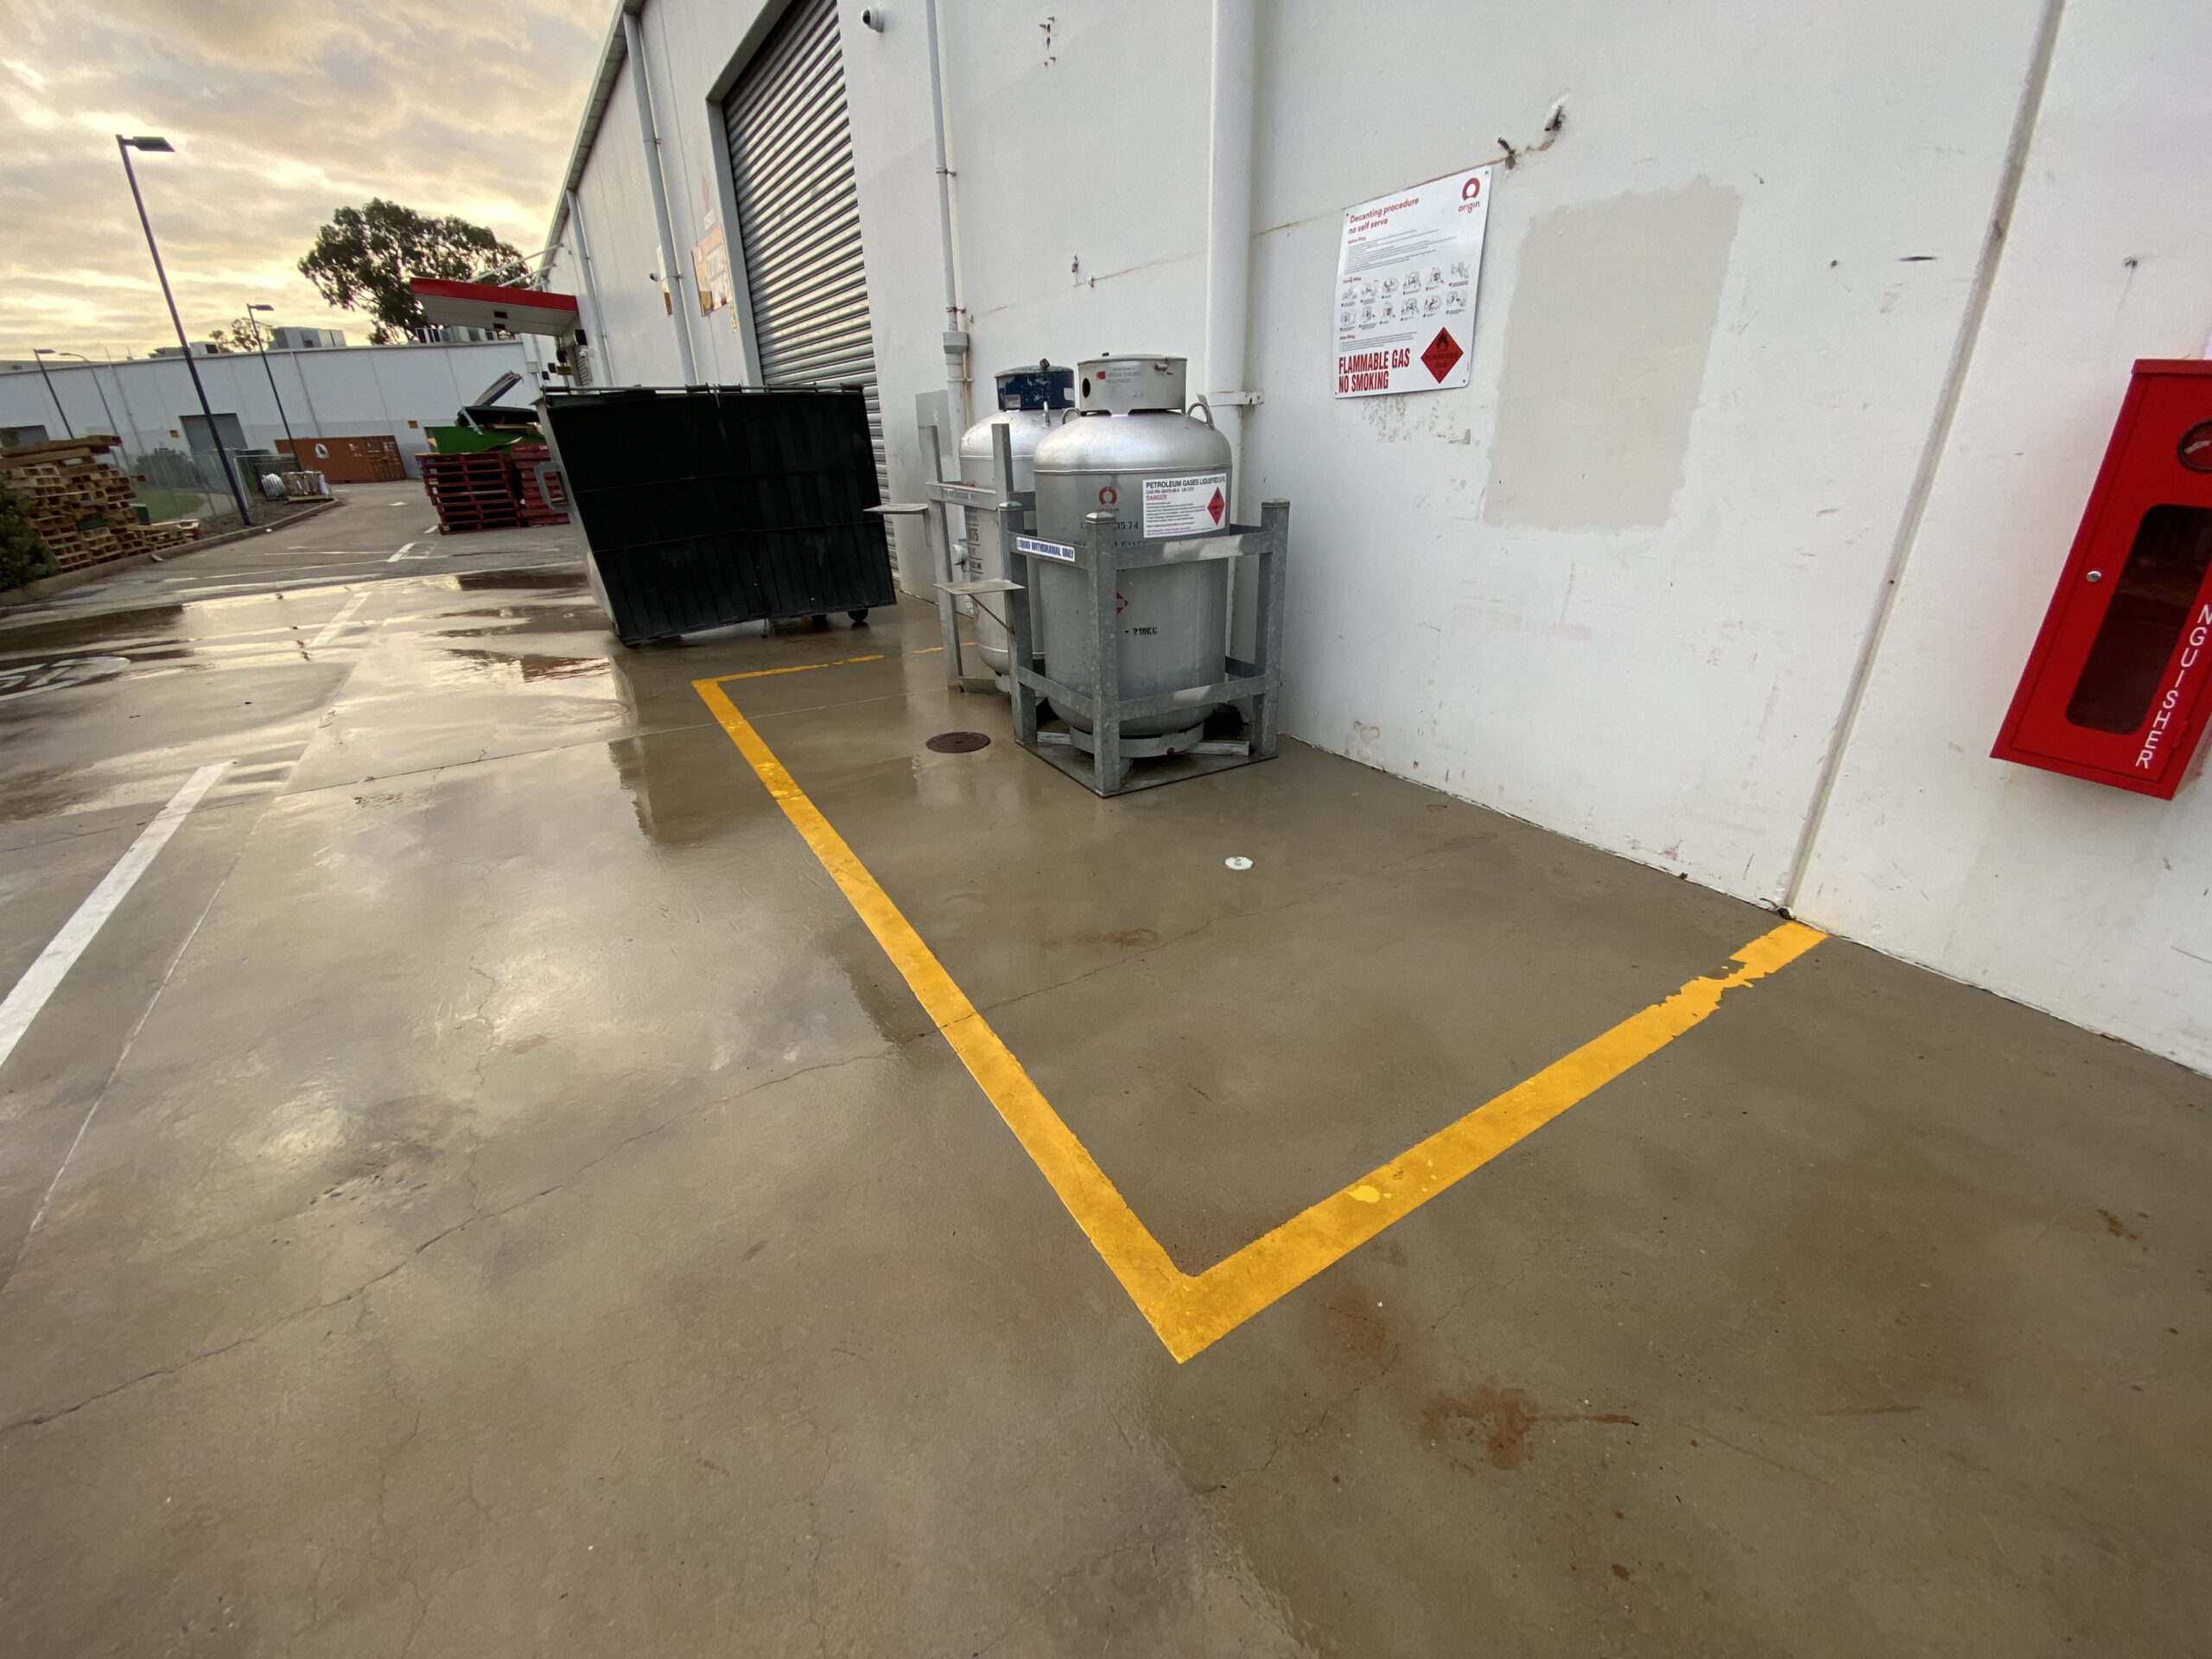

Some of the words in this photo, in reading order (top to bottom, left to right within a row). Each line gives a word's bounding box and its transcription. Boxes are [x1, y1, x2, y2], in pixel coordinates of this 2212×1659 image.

[1350, 209, 1382, 224] Decanting
[1382, 197, 1419, 216] procedure
[1459, 200, 1480, 213] origin
[1357, 222, 1370, 232] self
[1370, 218, 1388, 228] serve
[1338, 350, 1389, 374] FLAMMABLE
[1391, 347, 1410, 369] GAS
[1338, 375, 1349, 393] NO
[1351, 371, 1389, 392] SMOKING
[1146, 480, 1181, 489] PETROLEUM
[1031, 542, 1061, 556] WITHDRAWAL
[1062, 548, 1074, 558] ONLY
[1133, 626, 1158, 635] 210KG
